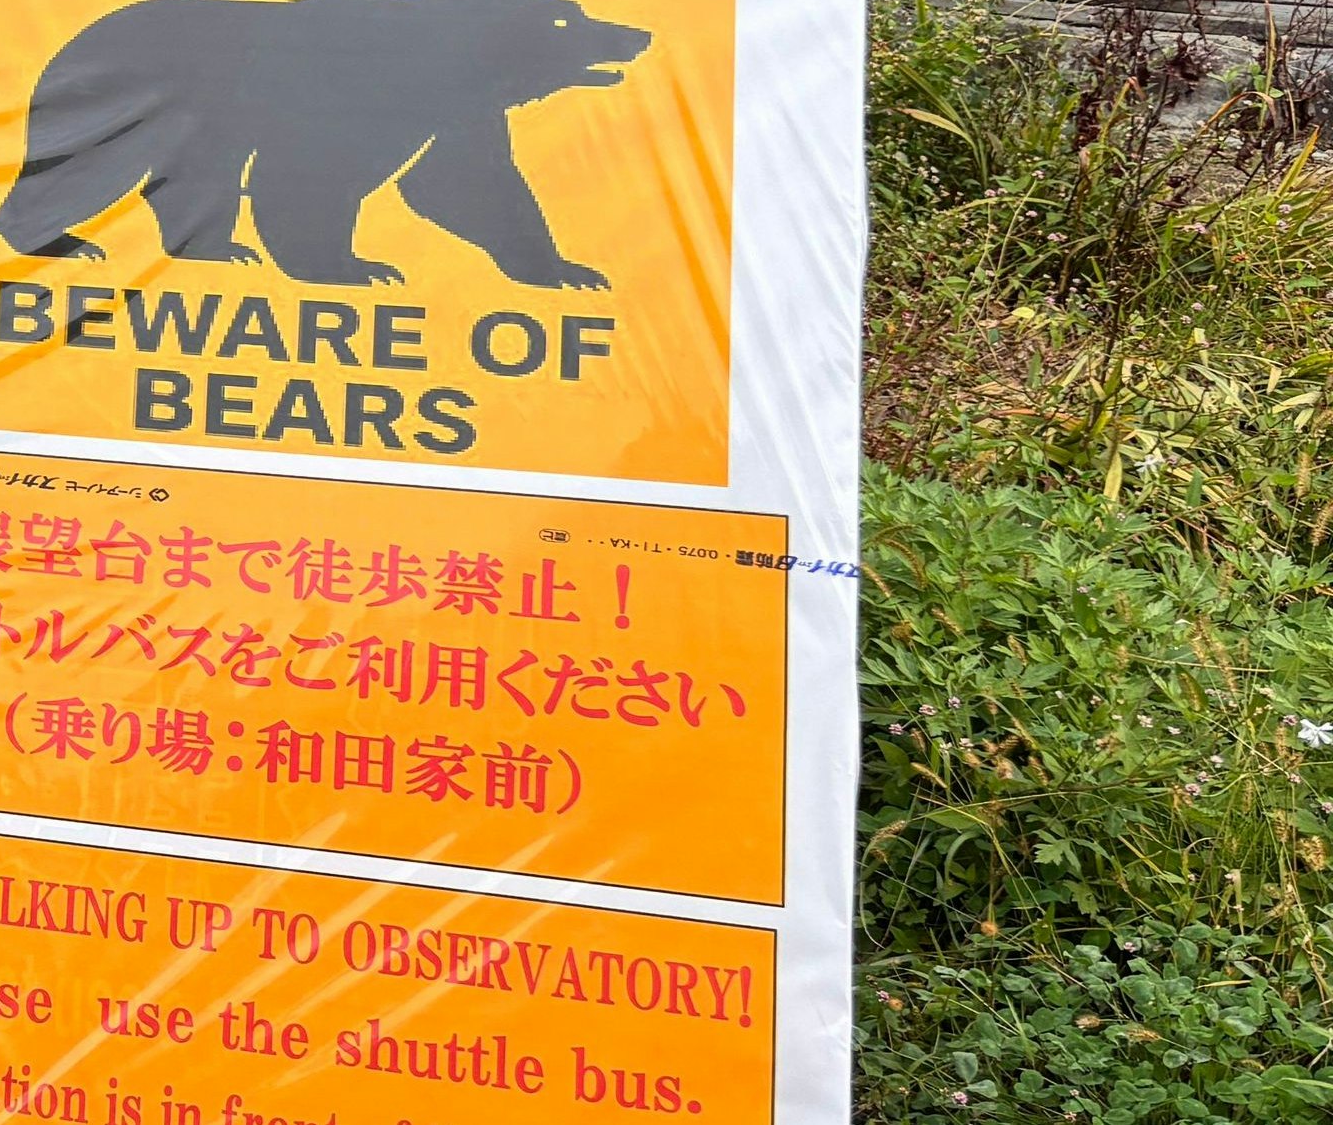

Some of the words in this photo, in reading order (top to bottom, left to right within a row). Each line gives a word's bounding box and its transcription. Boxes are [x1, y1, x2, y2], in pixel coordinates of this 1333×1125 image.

[469, 309, 616, 382] OF
[134, 367, 478, 454] BEARS
[4, 695, 582, 816] （乗り場：和田家前）
[167, 896, 233, 952] UP
[251, 907, 320, 965] TO
[342, 920, 752, 1028] OBSERVATORY!
[97, 996, 195, 1044] use
[218, 1000, 310, 1060] the
[336, 1018, 545, 1094] shuttle
[571, 1046, 703, 1114] bus.
[104, 1077, 143, 1125] is
[160, 1085, 202, 1125] in
